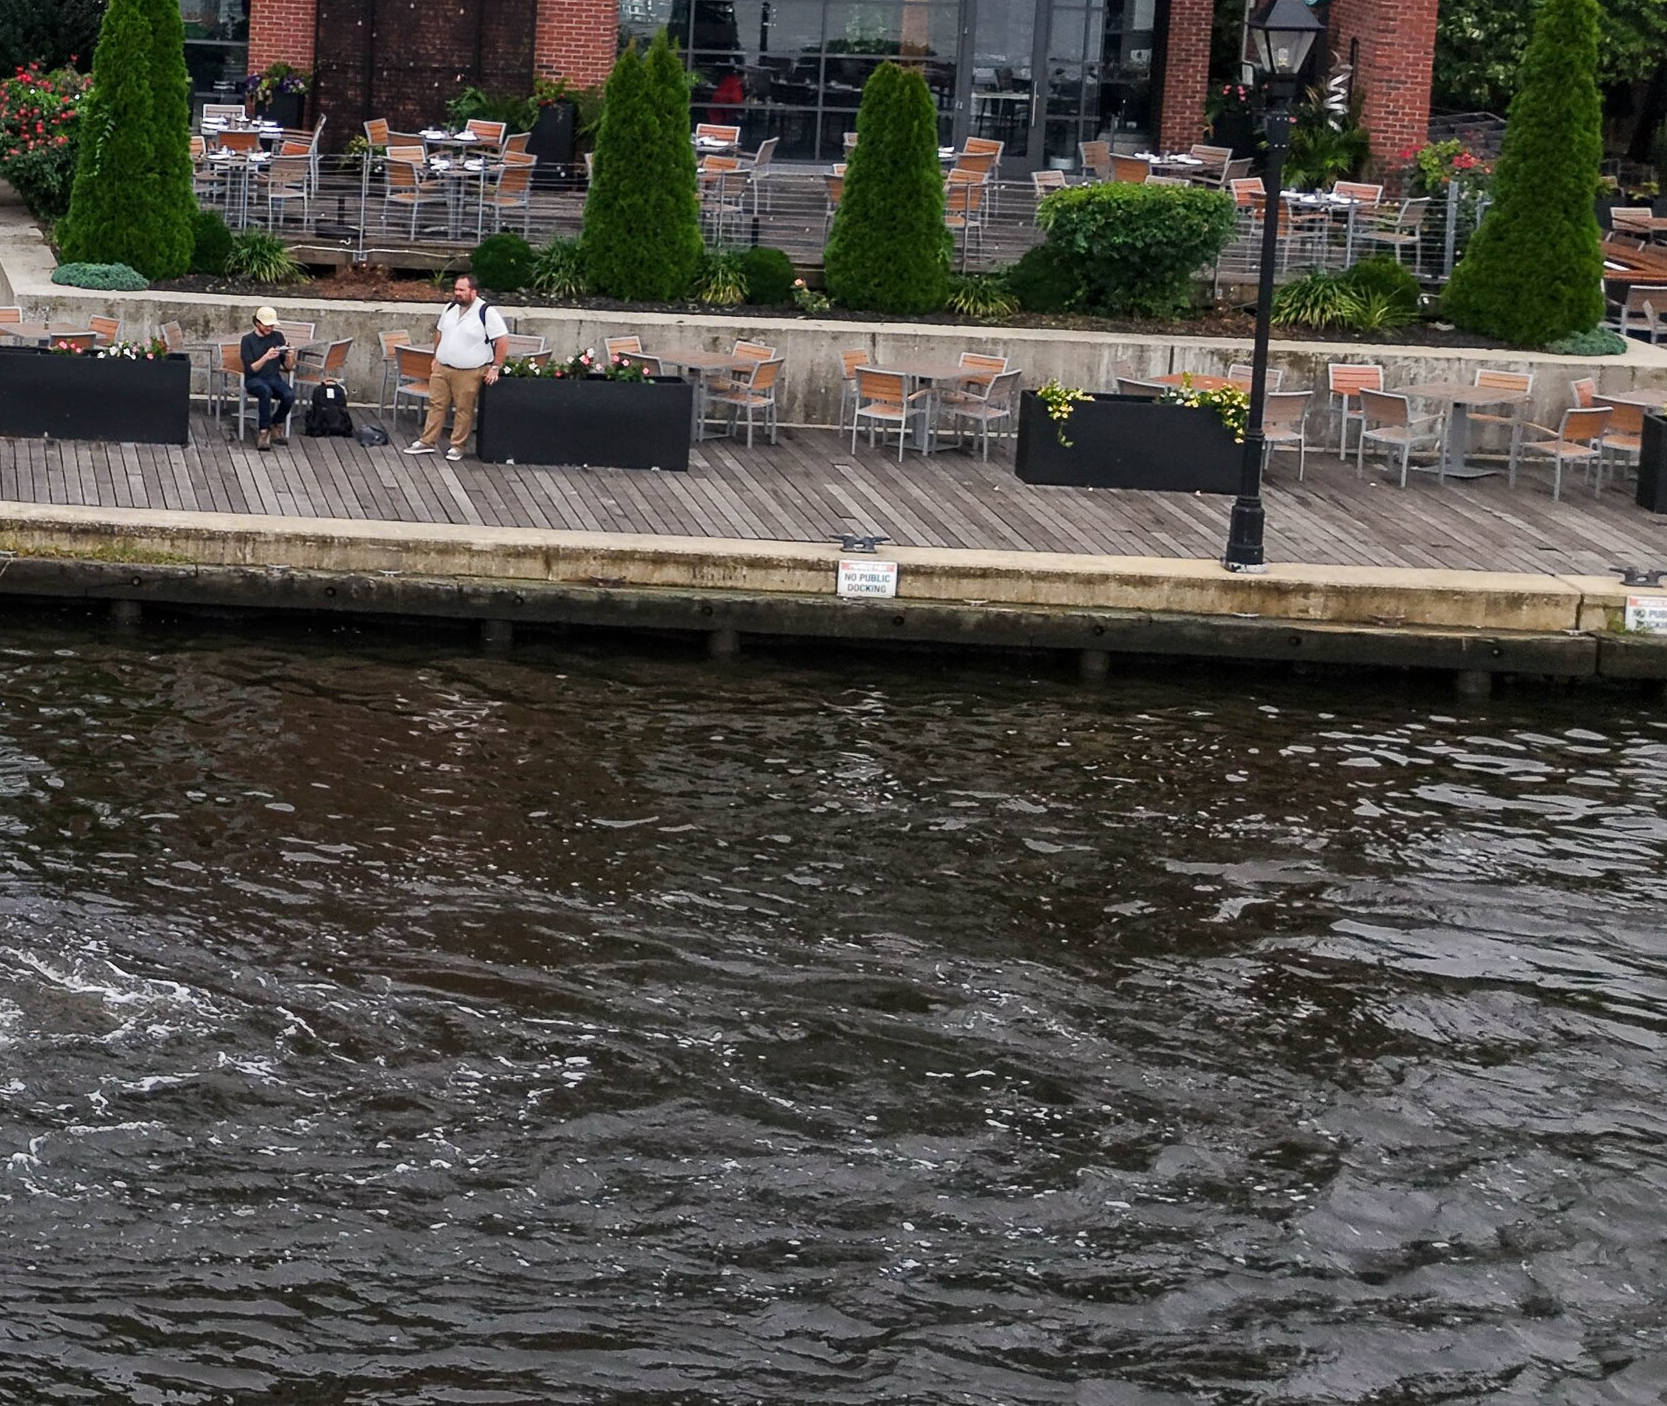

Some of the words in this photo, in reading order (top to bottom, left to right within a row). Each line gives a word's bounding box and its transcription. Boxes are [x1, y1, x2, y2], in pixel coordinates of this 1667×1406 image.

[844, 573, 857, 582] NO
[859, 573, 891, 583] PUBLIC
[847, 583, 887, 594] DOCKING
